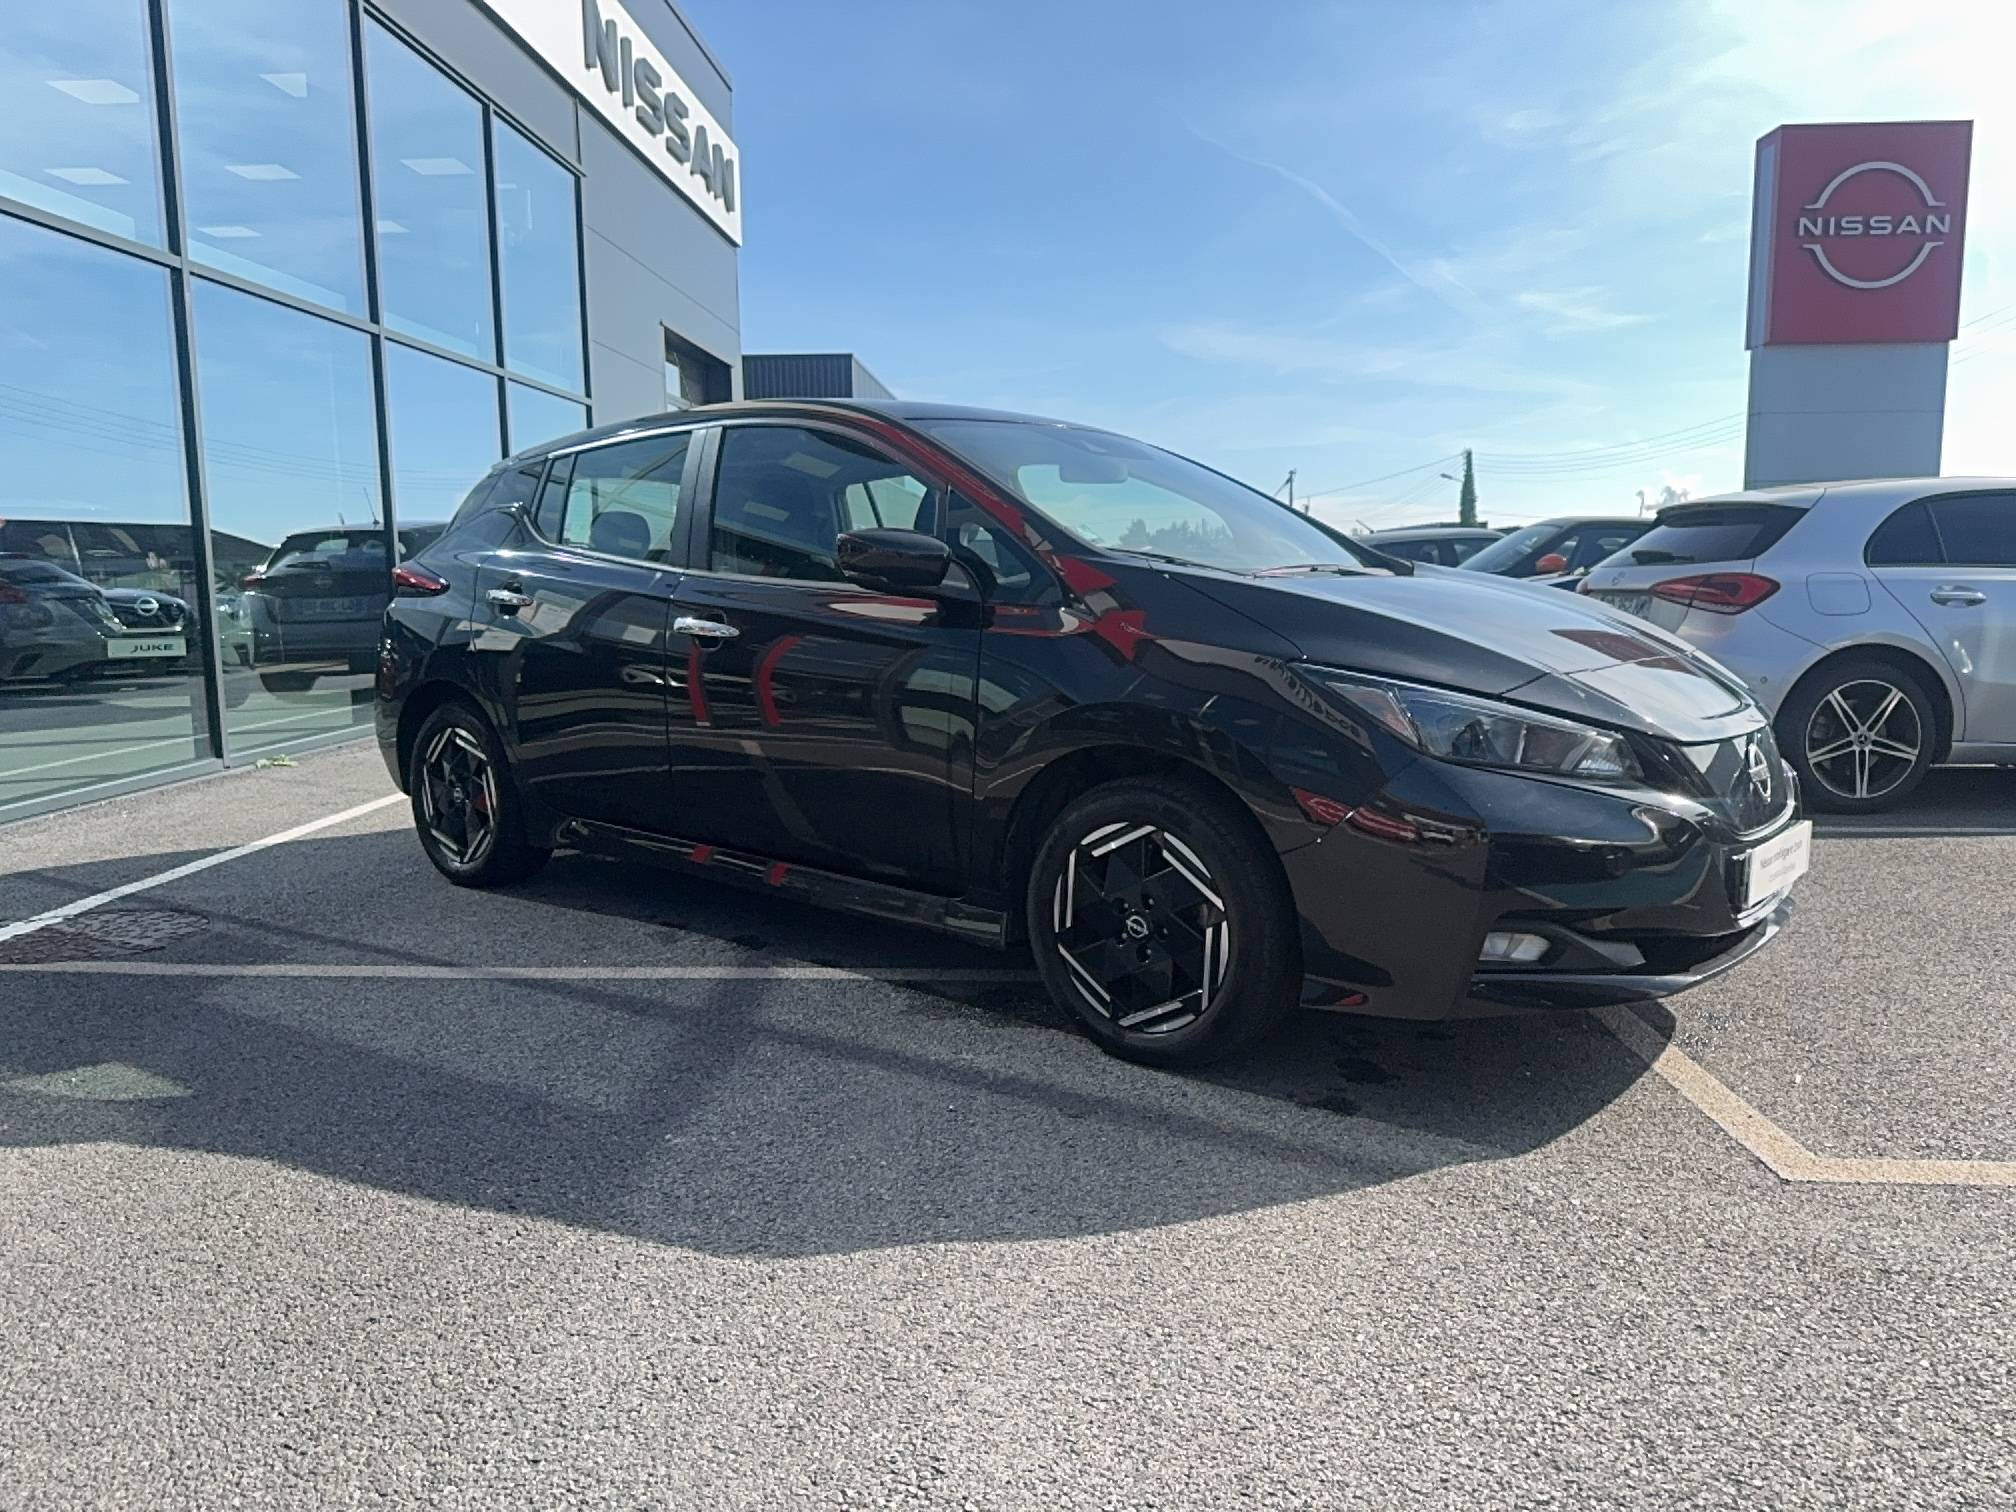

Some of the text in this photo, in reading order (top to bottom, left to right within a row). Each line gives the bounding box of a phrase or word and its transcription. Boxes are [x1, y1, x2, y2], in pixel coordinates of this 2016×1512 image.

[582, 0, 735, 213] NISSAN
[1799, 215, 1951, 236] NISSAN
[130, 643, 176, 653] JUKE
